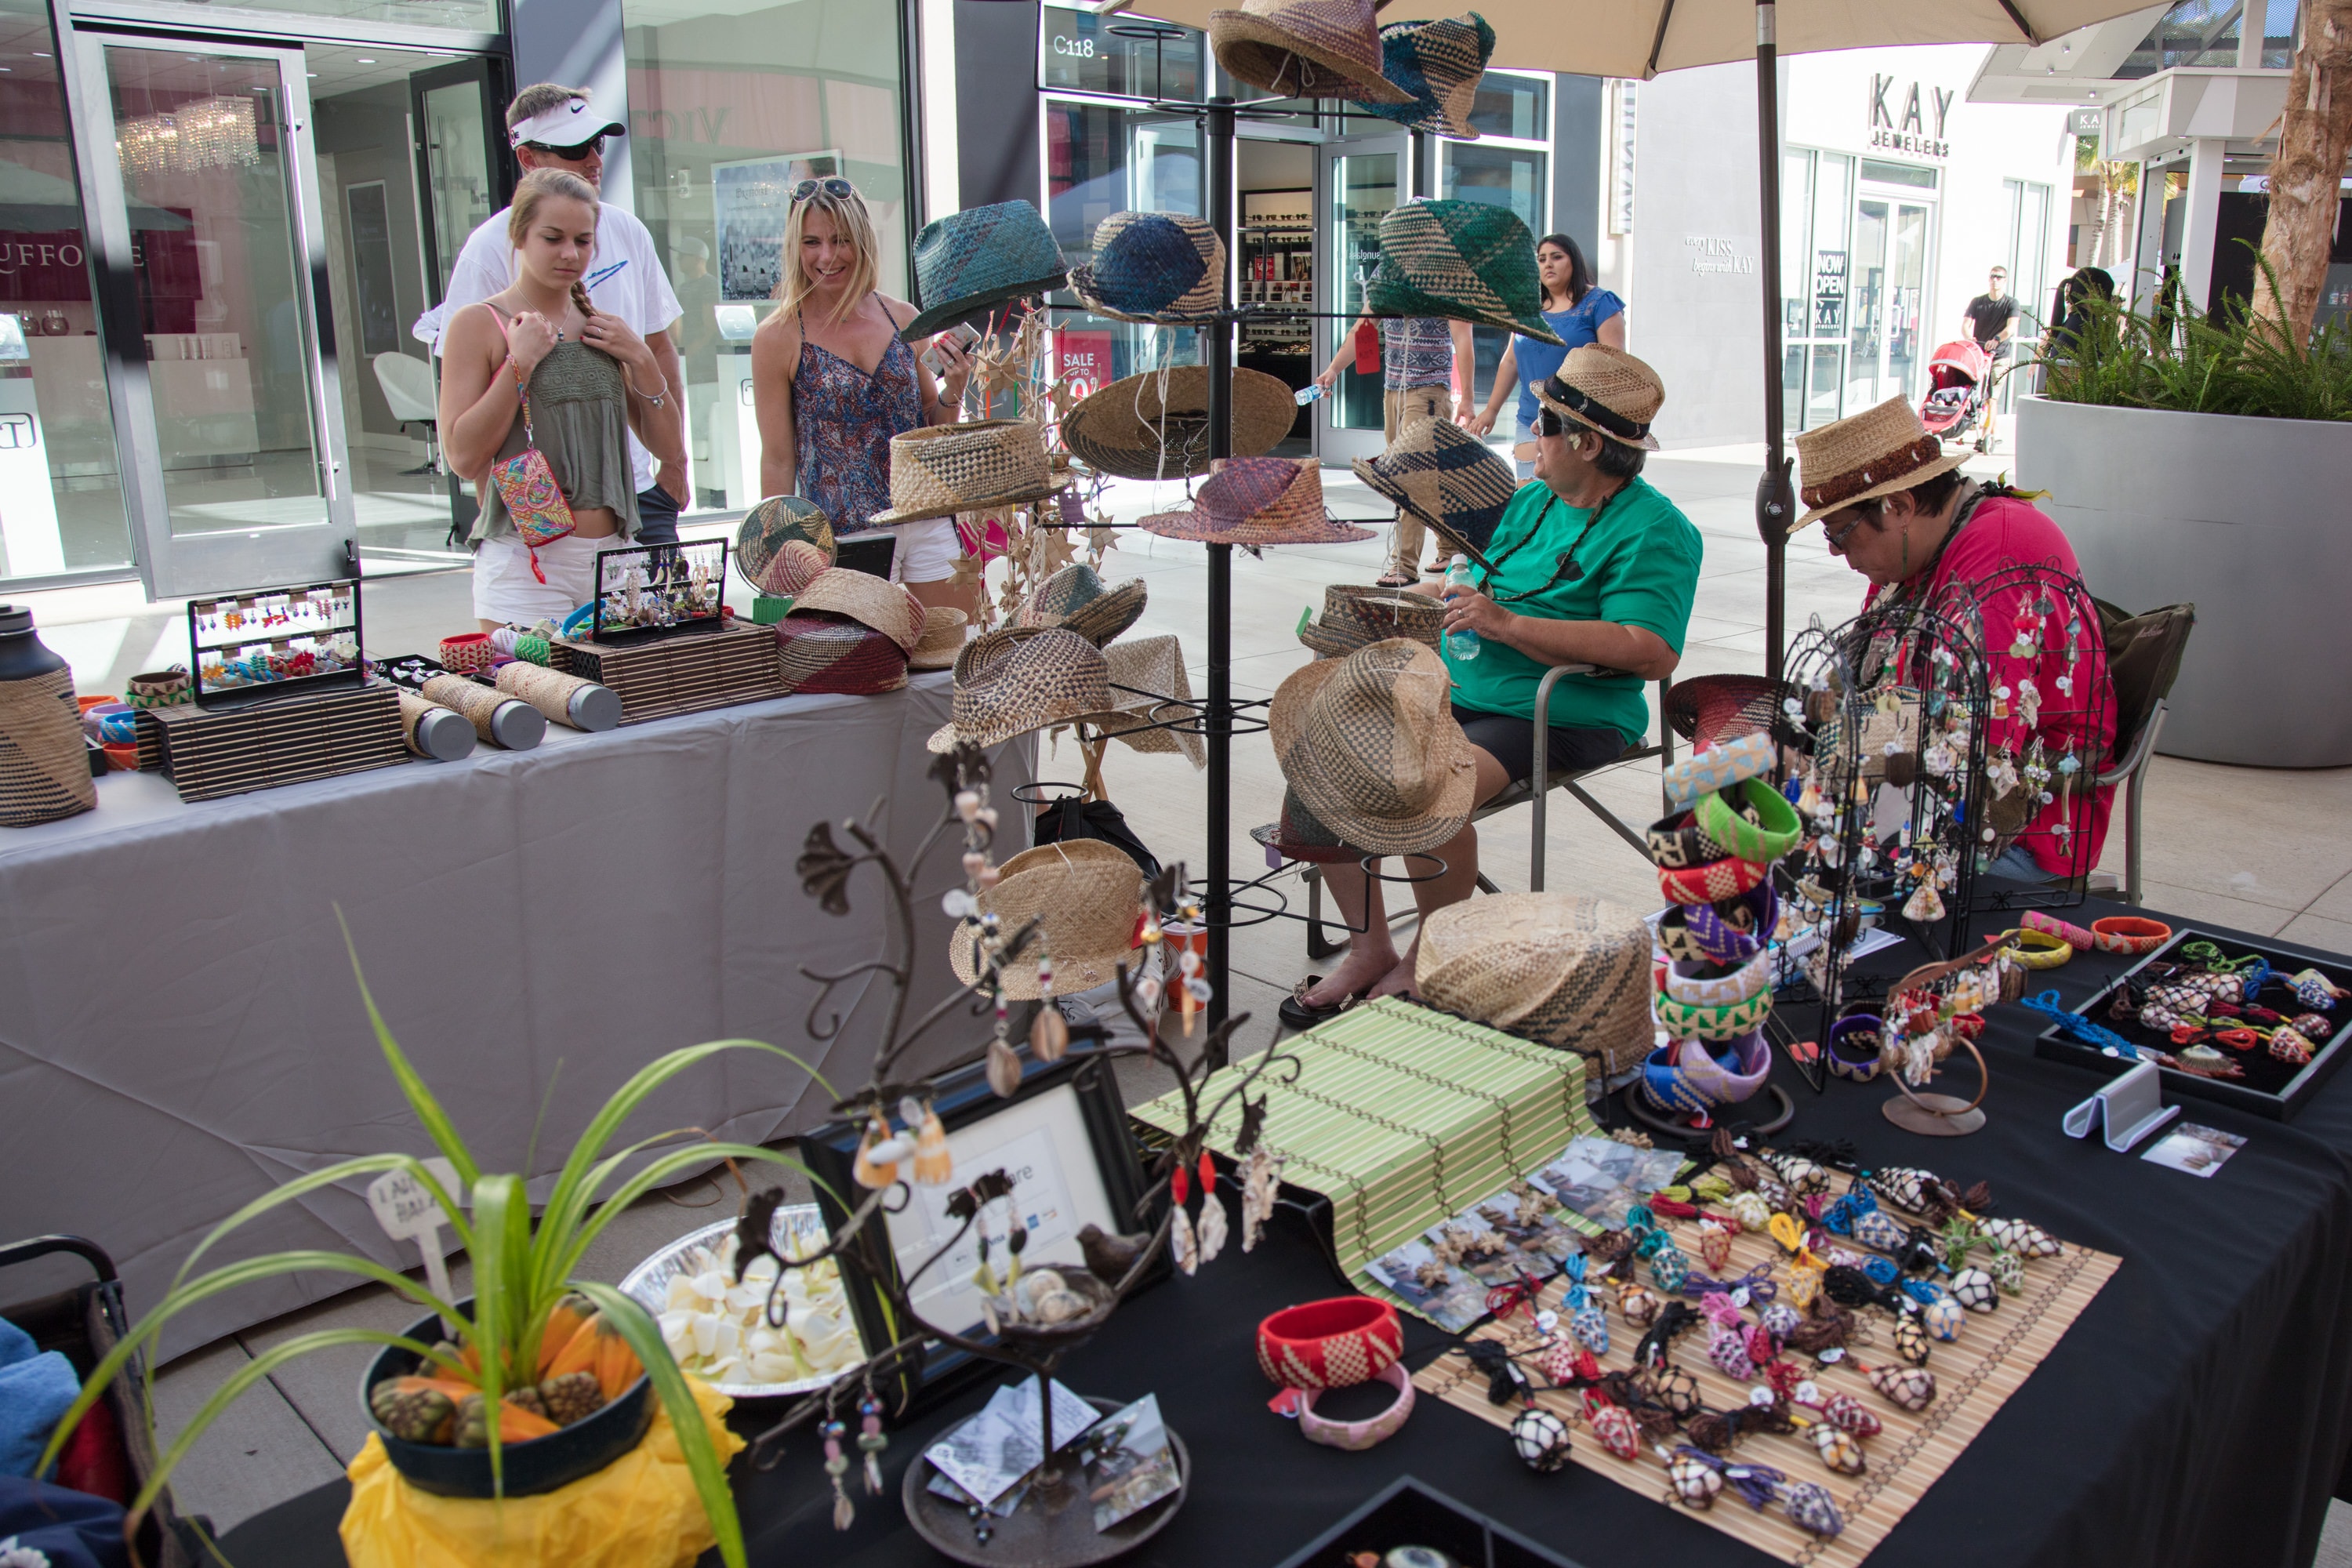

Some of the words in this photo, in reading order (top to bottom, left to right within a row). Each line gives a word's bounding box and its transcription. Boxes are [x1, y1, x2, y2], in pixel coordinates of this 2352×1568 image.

[1054, 34, 1094, 58] C118
[1872, 72, 1955, 139] KAY
[2080, 114, 2100, 125] KA
[1871, 130, 1949, 158] JEWELERS
[1685, 236, 1704, 251] every
[1705, 238, 1732, 256] KISS
[1731, 255, 1754, 274] KAY
[1818, 254, 1844, 274] NOW
[1817, 274, 1844, 294] OPEN
[1815, 309, 1840, 324] KAY
[1063, 353, 1094, 367] SALE
